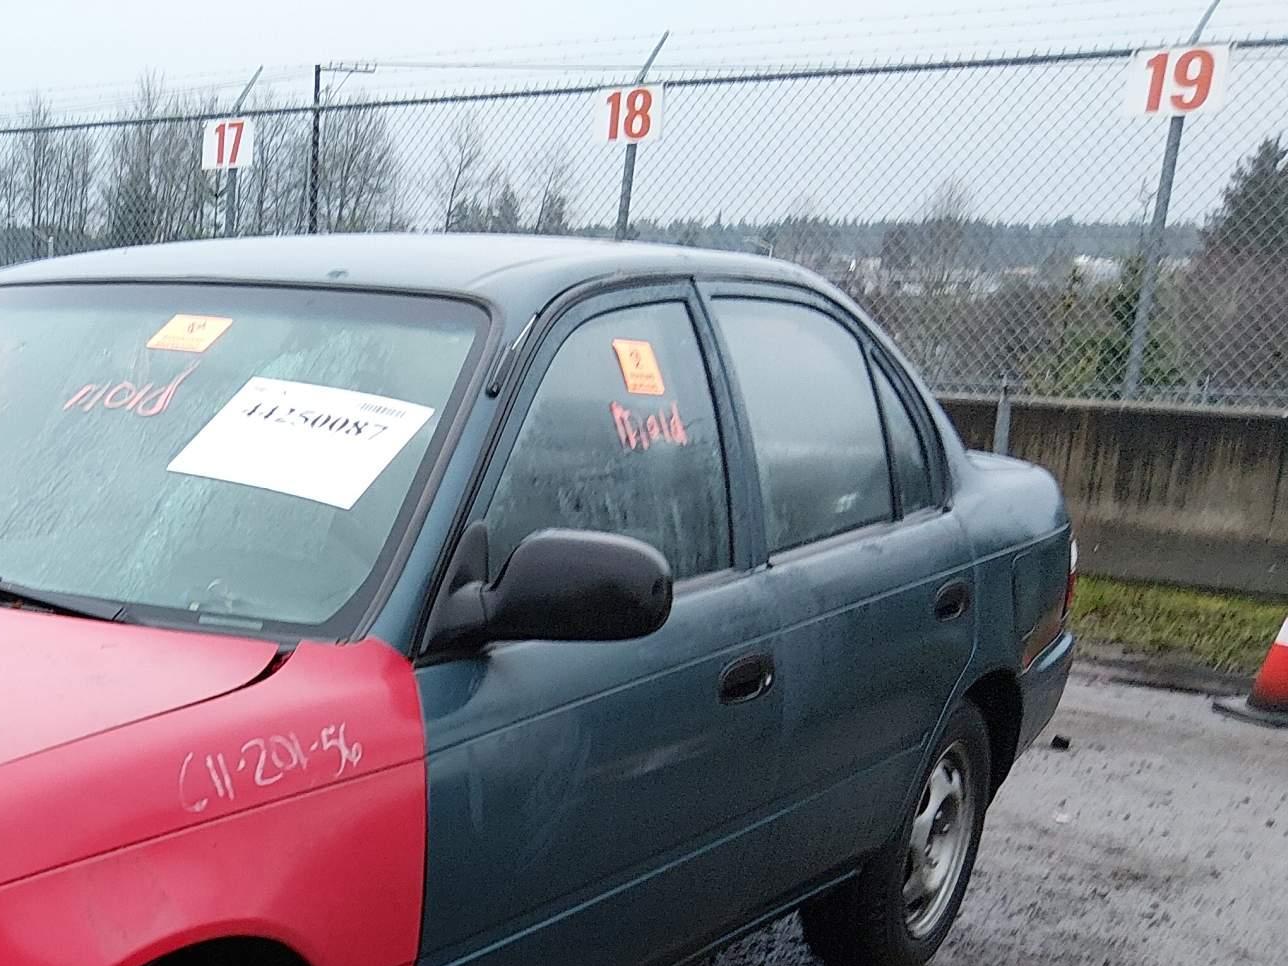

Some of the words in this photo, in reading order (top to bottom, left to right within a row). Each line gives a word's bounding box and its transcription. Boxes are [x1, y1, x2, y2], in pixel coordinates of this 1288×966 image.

[1144, 49, 1216, 113] 19
[606, 88, 653, 141] 18
[214, 120, 245, 166] 17
